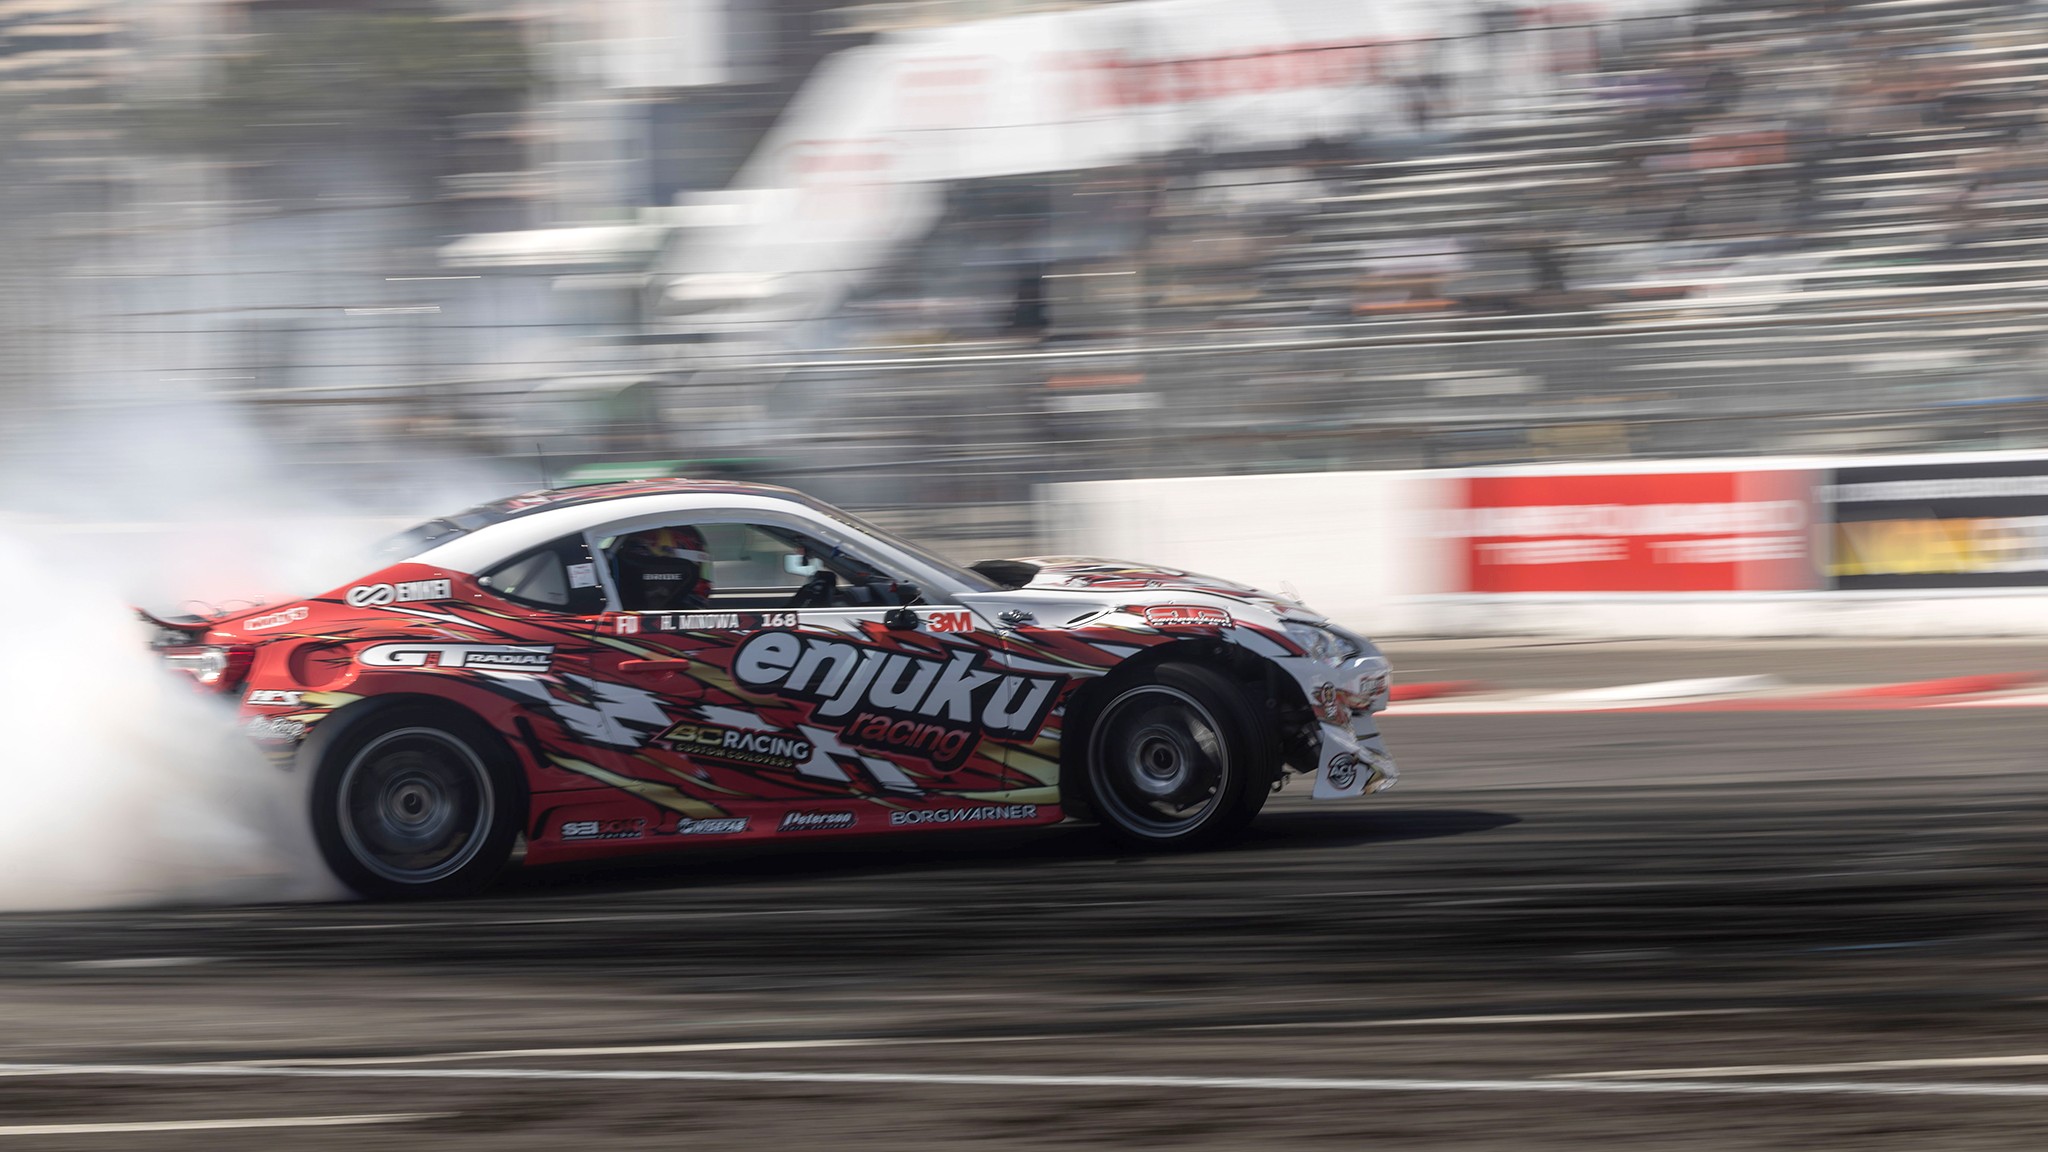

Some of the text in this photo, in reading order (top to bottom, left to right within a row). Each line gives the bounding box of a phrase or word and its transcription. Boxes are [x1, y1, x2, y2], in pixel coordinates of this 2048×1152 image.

[760, 613, 798, 627] 168
[928, 611, 974, 633] 3M
[359, 644, 552, 667] GT RADIAL
[735, 631, 1057, 732] enjuku
[722, 730, 809, 760] RACING
[846, 711, 972, 761] racing
[891, 806, 1037, 826] BORGWARNER
